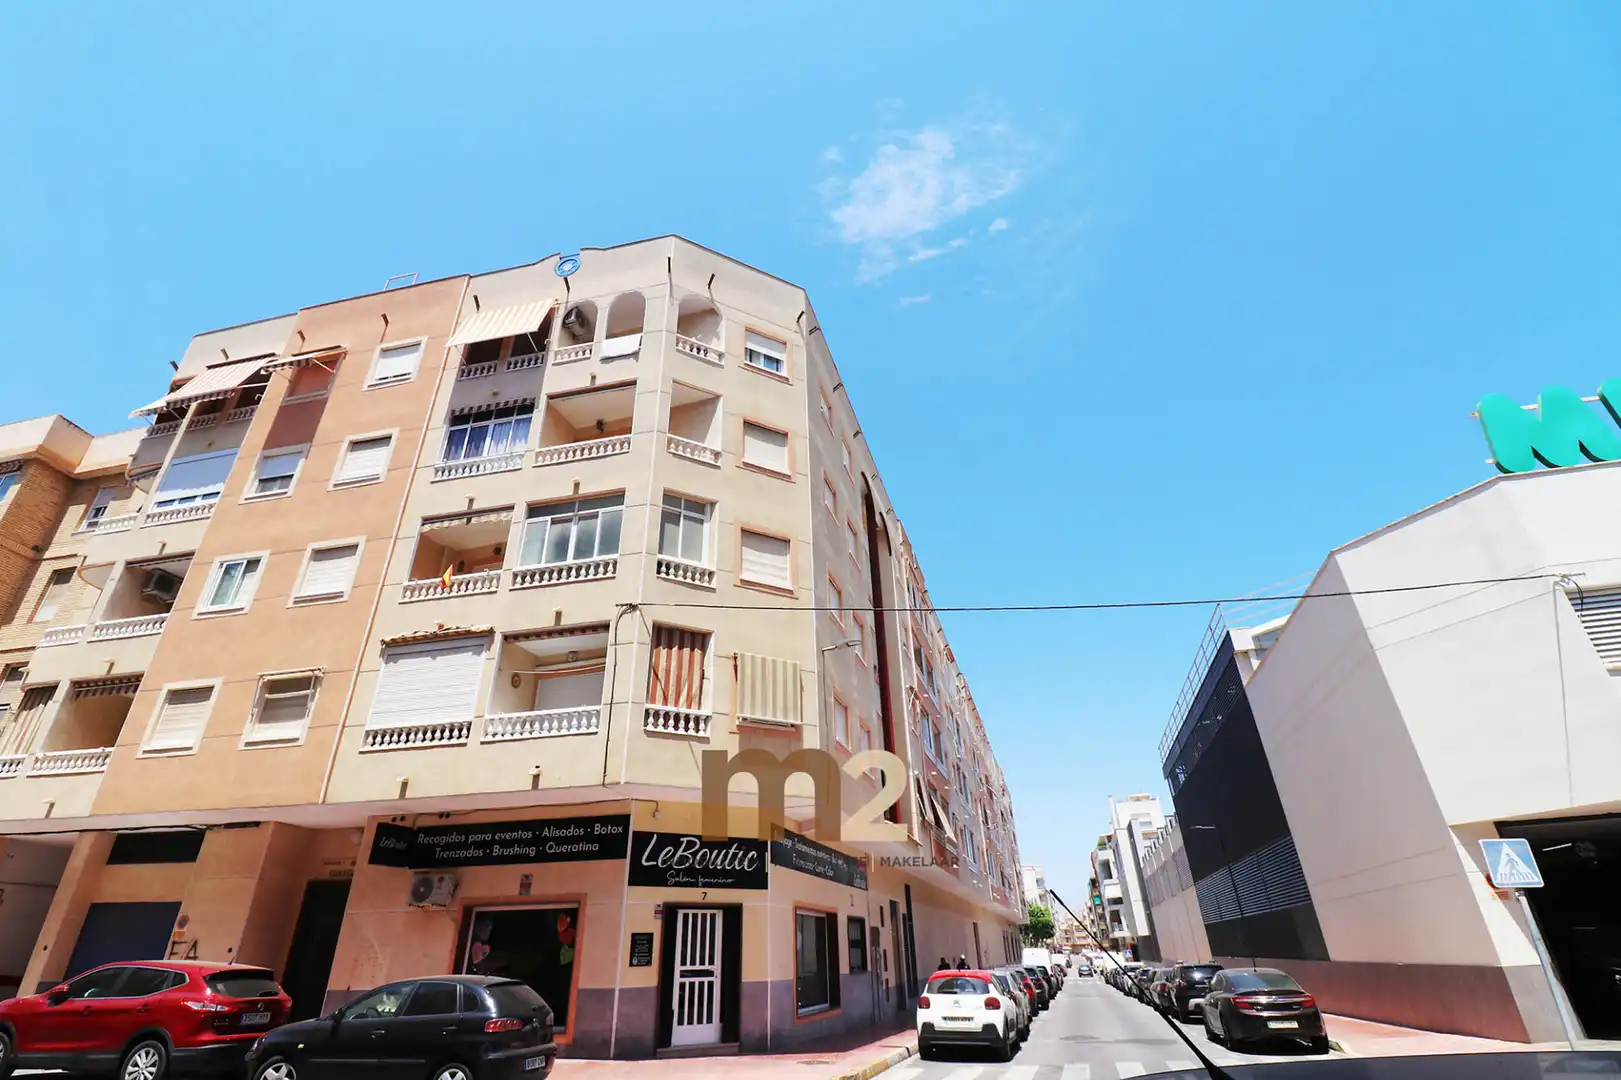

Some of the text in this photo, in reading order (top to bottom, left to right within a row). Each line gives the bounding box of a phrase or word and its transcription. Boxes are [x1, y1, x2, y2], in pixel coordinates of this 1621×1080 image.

[417, 823, 624, 846] Recogidos para eventos Alisados Botox
[435, 841, 599, 859] Trenzados Brushing Queratina
[640, 833, 760, 871] LeBoutic
[701, 891, 708, 901] 7
